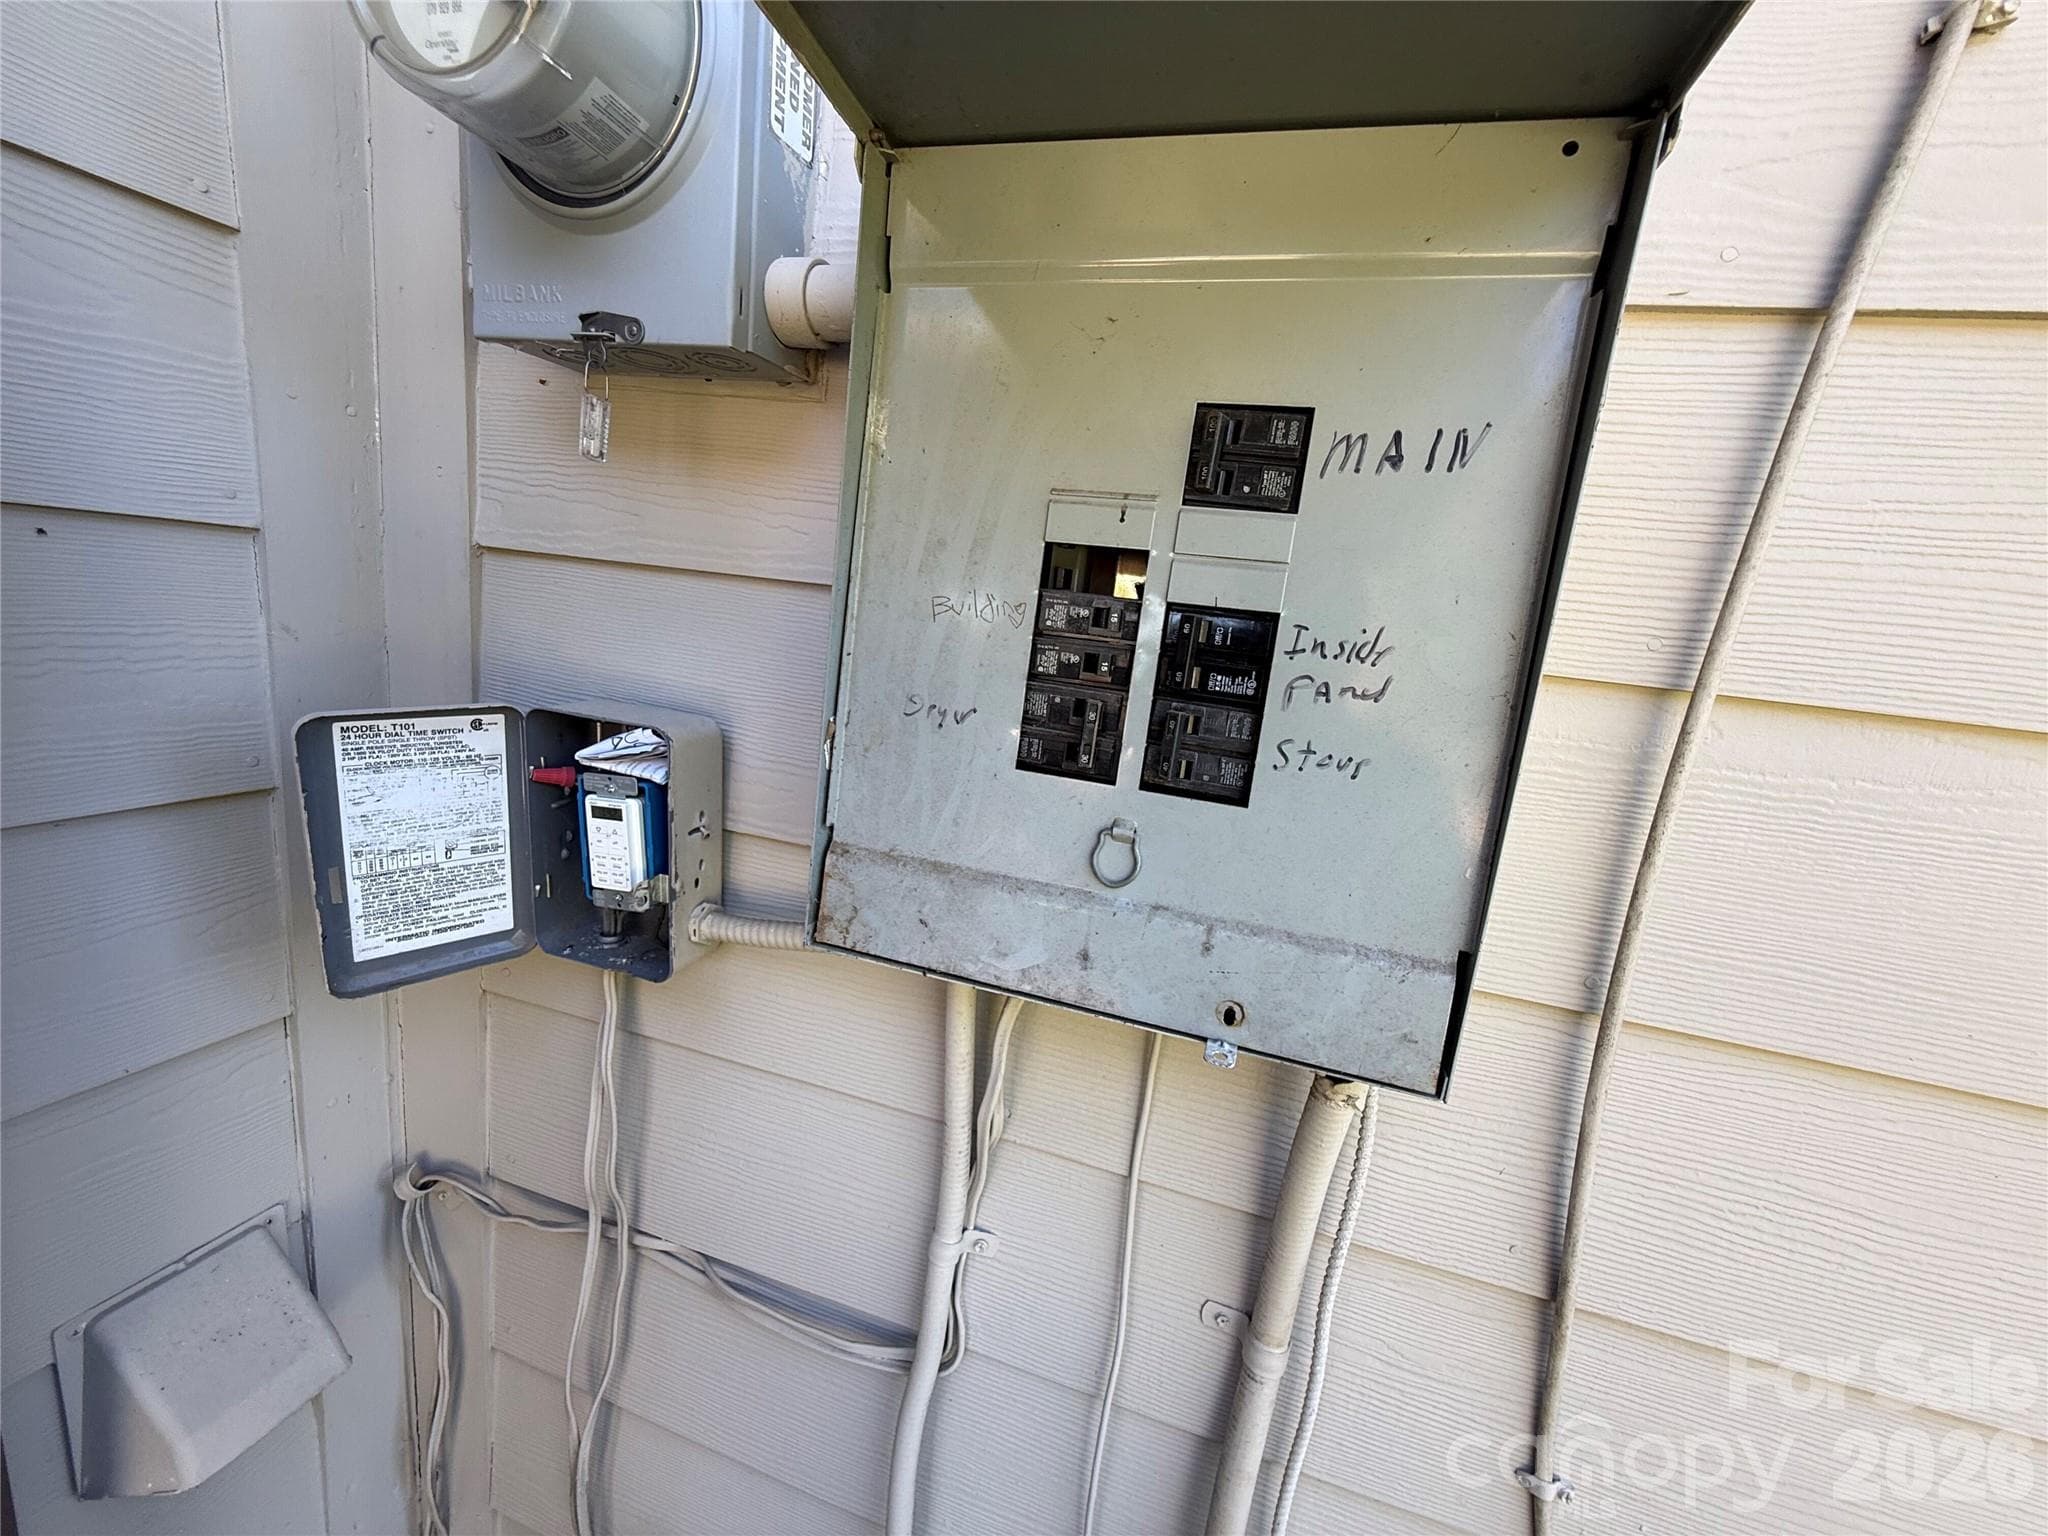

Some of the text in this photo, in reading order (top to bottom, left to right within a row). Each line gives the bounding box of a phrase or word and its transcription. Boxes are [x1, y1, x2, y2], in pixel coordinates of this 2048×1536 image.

[1319, 422, 1493, 479] MAIN
[931, 589, 1027, 629] Building
[1110, 613, 1119, 623] 15
[1100, 662, 1109, 672] 15
[1088, 711, 1097, 721] 30
[340, 722, 415, 734] MODEL: T101
[1168, 720, 1176, 730] 40
[354, 732, 382, 740] HOUR
[1080, 754, 1089, 763] 30
[1161, 762, 1169, 772] 40
